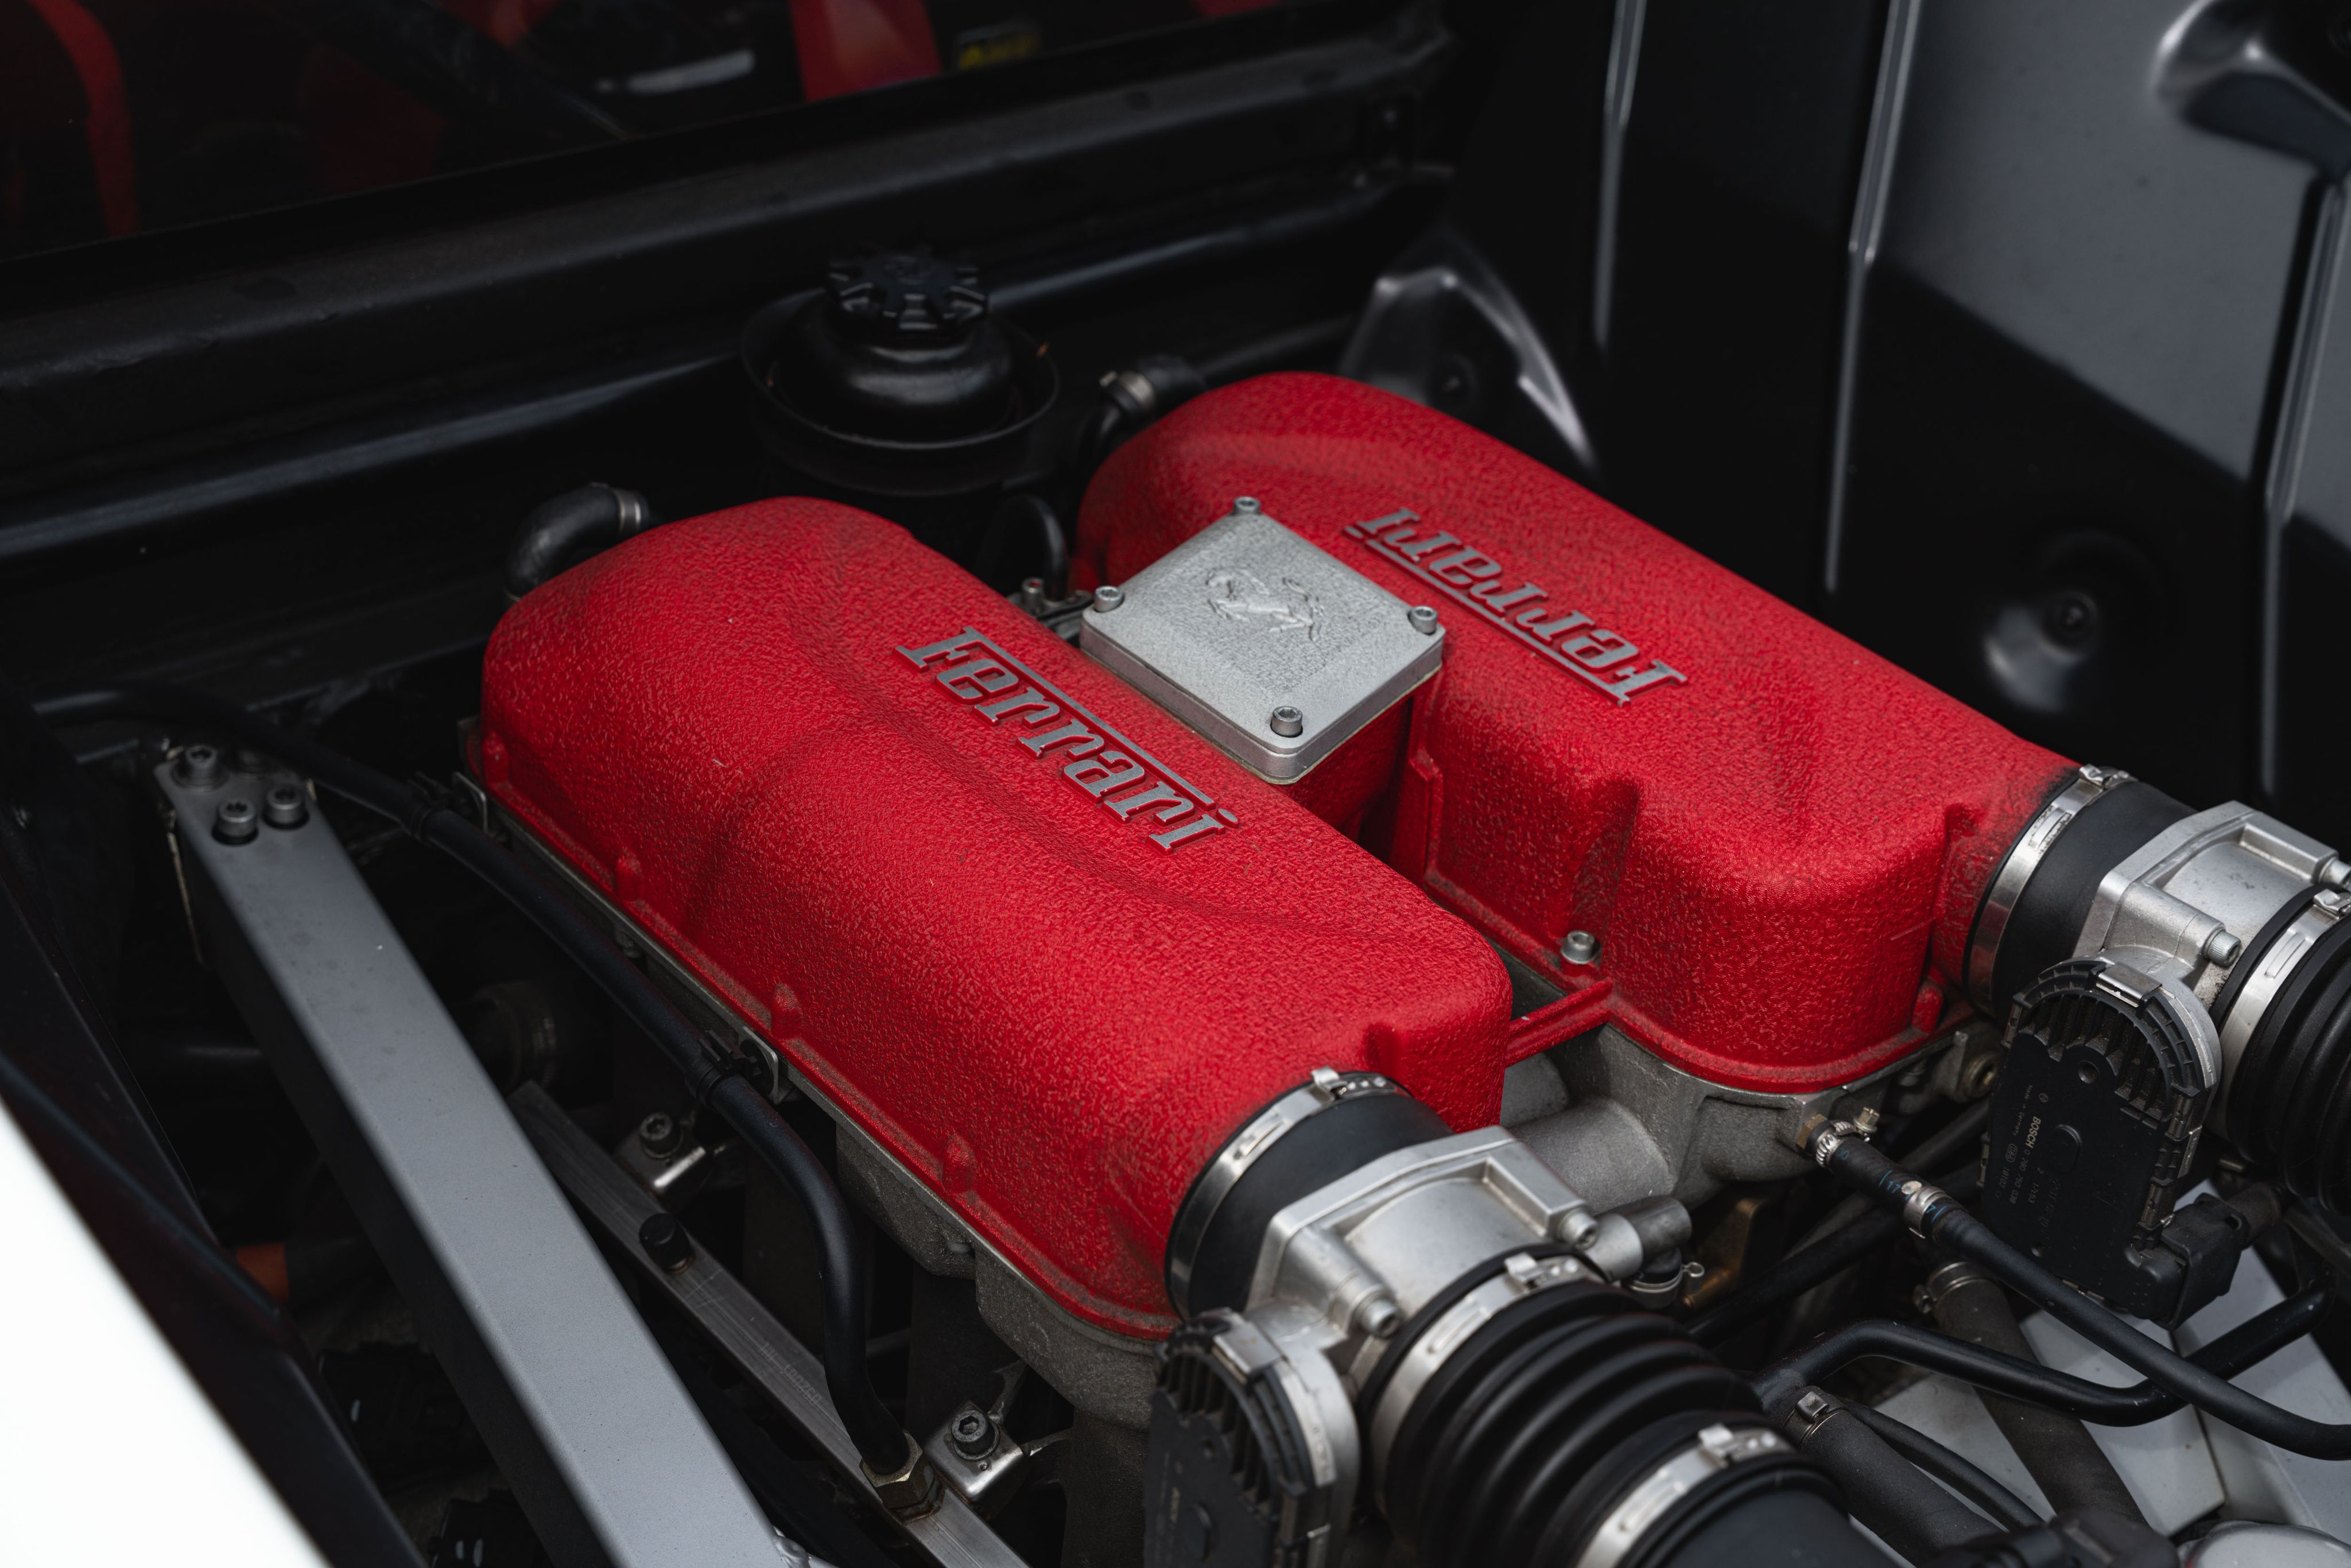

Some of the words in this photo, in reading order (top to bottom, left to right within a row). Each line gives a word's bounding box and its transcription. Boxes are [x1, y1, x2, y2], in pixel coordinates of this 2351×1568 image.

[1343, 507, 1686, 706] Ferrari
[893, 626, 1239, 855] Ferrari
[2025, 1084, 2033, 1100] Made
[2012, 1111, 2025, 1136] Germany
[2025, 1116, 2042, 1148] BOSCH
[2019, 1156, 2028, 1171] 280
